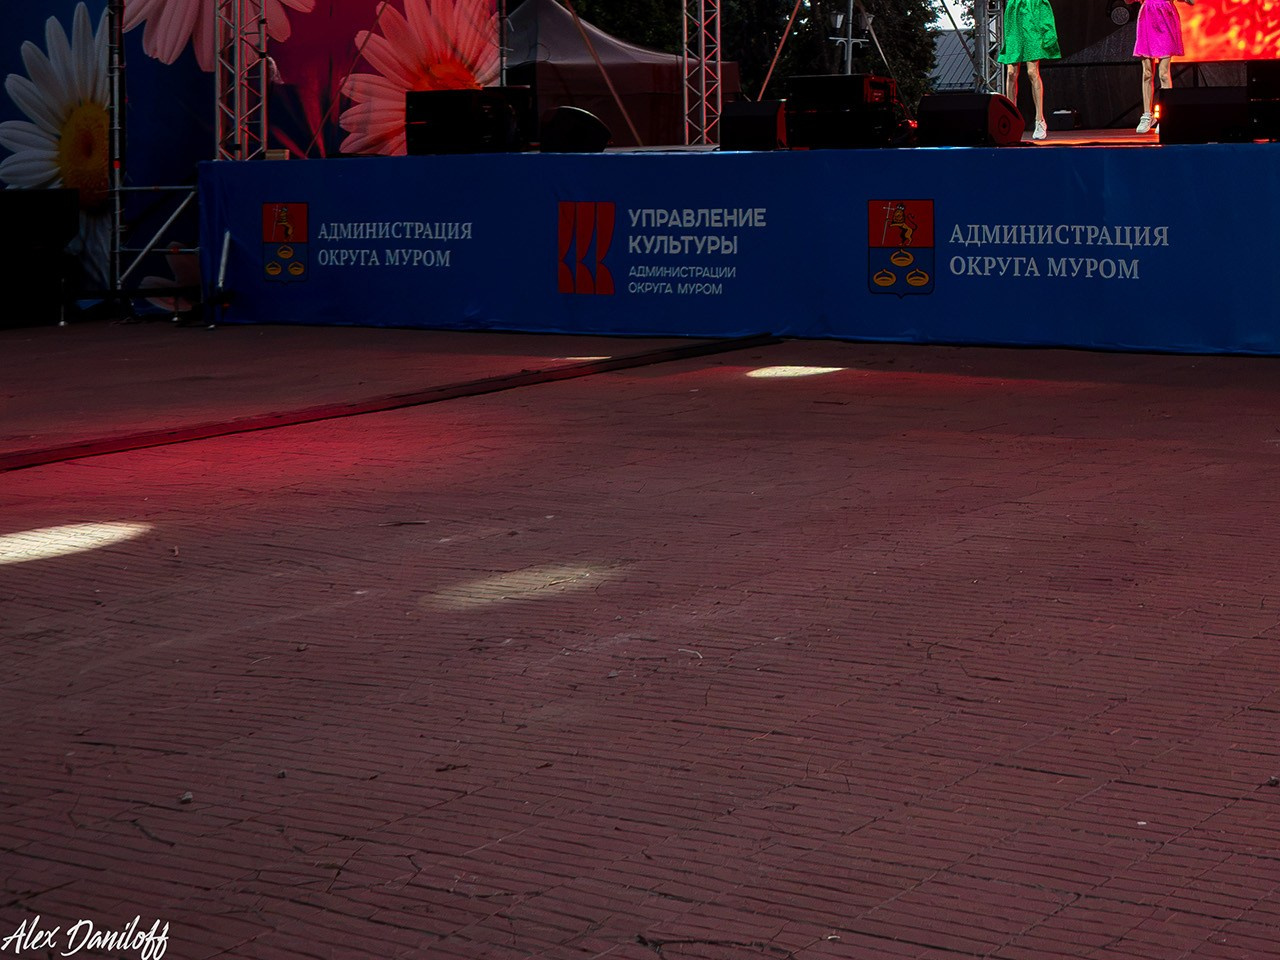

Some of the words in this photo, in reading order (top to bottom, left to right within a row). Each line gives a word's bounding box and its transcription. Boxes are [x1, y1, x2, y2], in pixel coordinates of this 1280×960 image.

[627, 208, 767, 228] УПРАВЛЕНИЕ
[317, 221, 473, 242] АДМИНИСТРАЦИЯ
[948, 223, 1170, 250] АДМИНИСТРАЦИЯ
[628, 235, 738, 255] КУЛЬТУРЫ
[318, 249, 380, 266] ОКРУГА
[385, 248, 451, 268] МУРОМ
[949, 255, 1041, 277] ОКРУГА
[1047, 257, 1140, 280] МУРОМ
[628, 265, 736, 279] АДМИНИСТРАЦИИ
[628, 282, 673, 294] ОКРУГА
[677, 283, 723, 295] МУРОМ
